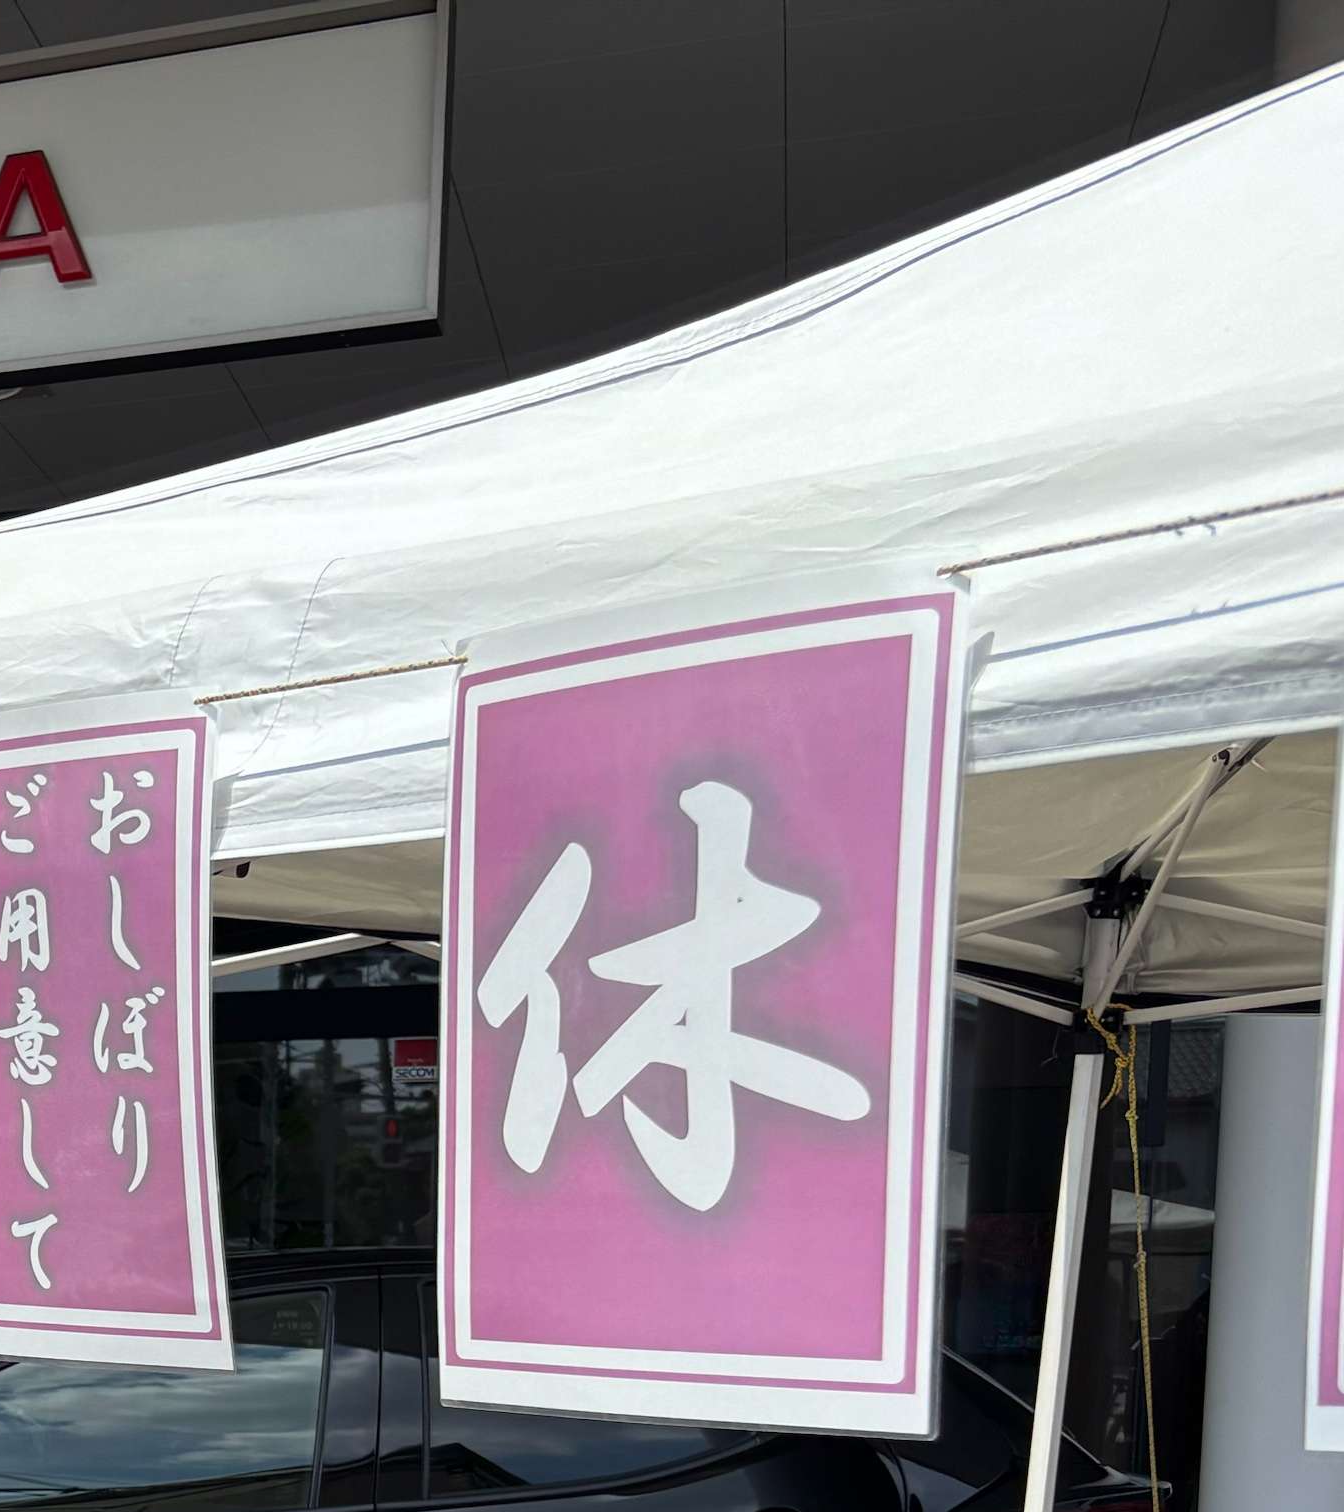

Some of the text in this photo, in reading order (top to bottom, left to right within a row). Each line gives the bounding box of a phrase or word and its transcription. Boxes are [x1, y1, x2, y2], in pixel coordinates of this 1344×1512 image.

[89, 770, 165, 1194] おしぼり
[476, 780, 871, 1212] 休
